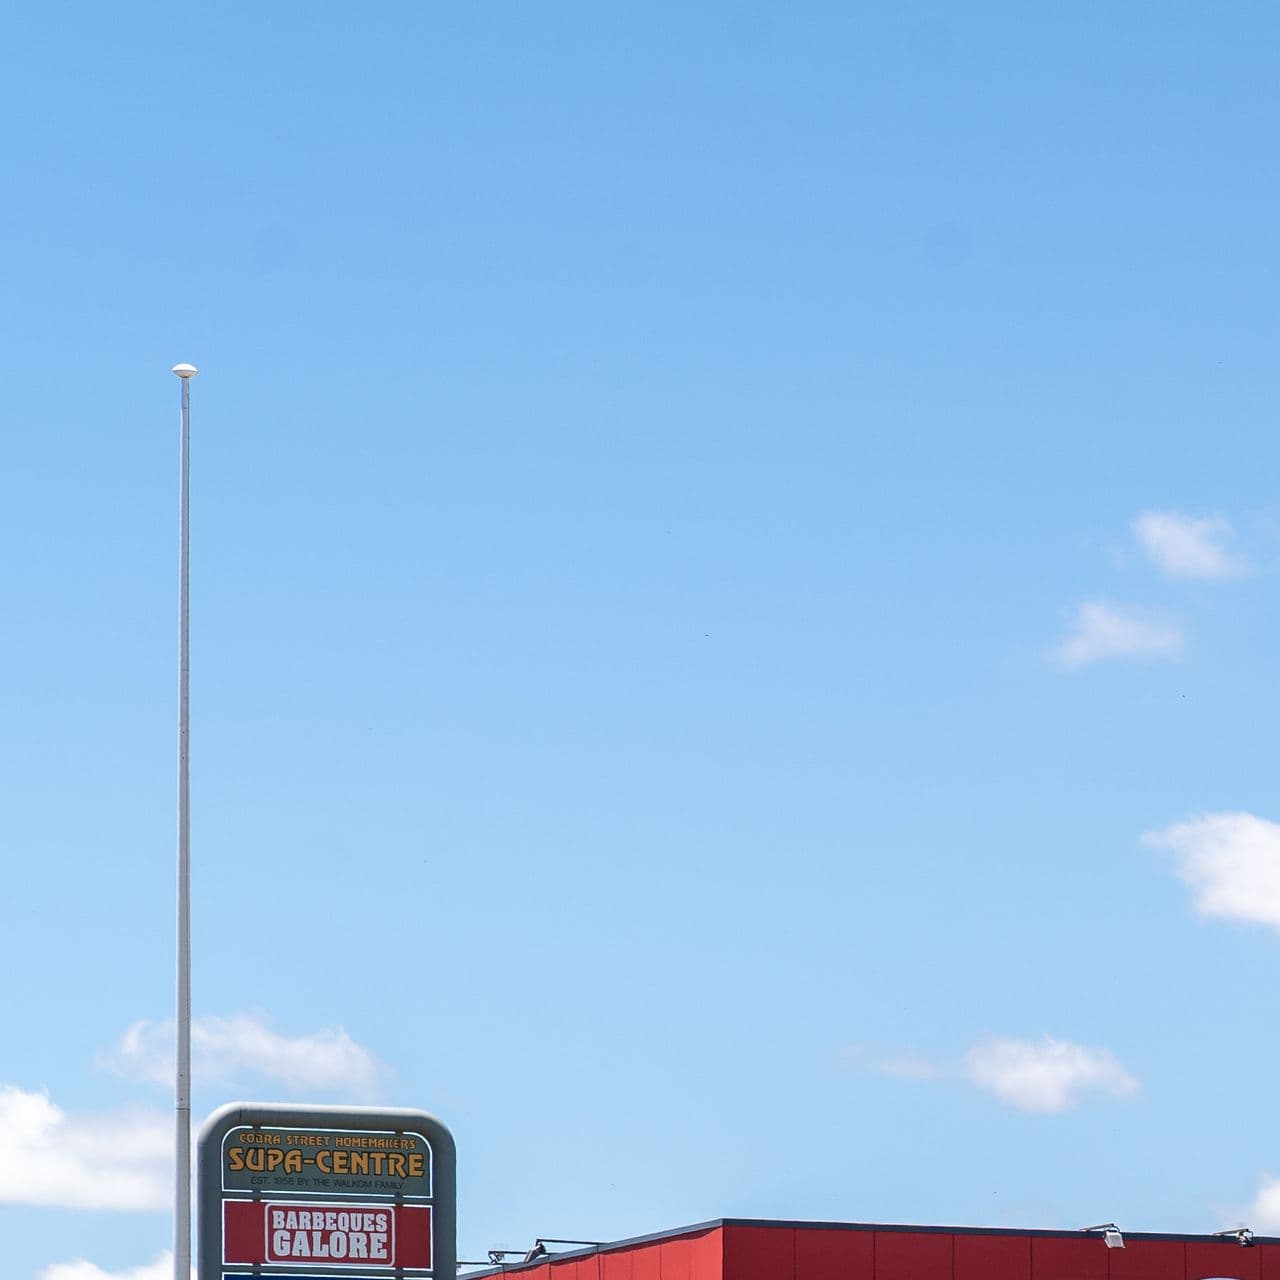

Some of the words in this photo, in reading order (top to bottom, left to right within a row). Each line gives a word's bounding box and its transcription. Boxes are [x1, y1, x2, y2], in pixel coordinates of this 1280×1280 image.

[239, 1133, 281, 1145] COBRA
[286, 1135, 330, 1147] STREET
[335, 1137, 416, 1150] HOMEMAKERS
[229, 1147, 425, 1179] SUPA-CENTRE
[297, 1177, 310, 1187] BY
[313, 1178, 330, 1187] THE
[374, 1181, 404, 1190] FAMILY
[272, 1209, 388, 1232] BARBEQUES
[272, 1231, 388, 1260] GALORE
